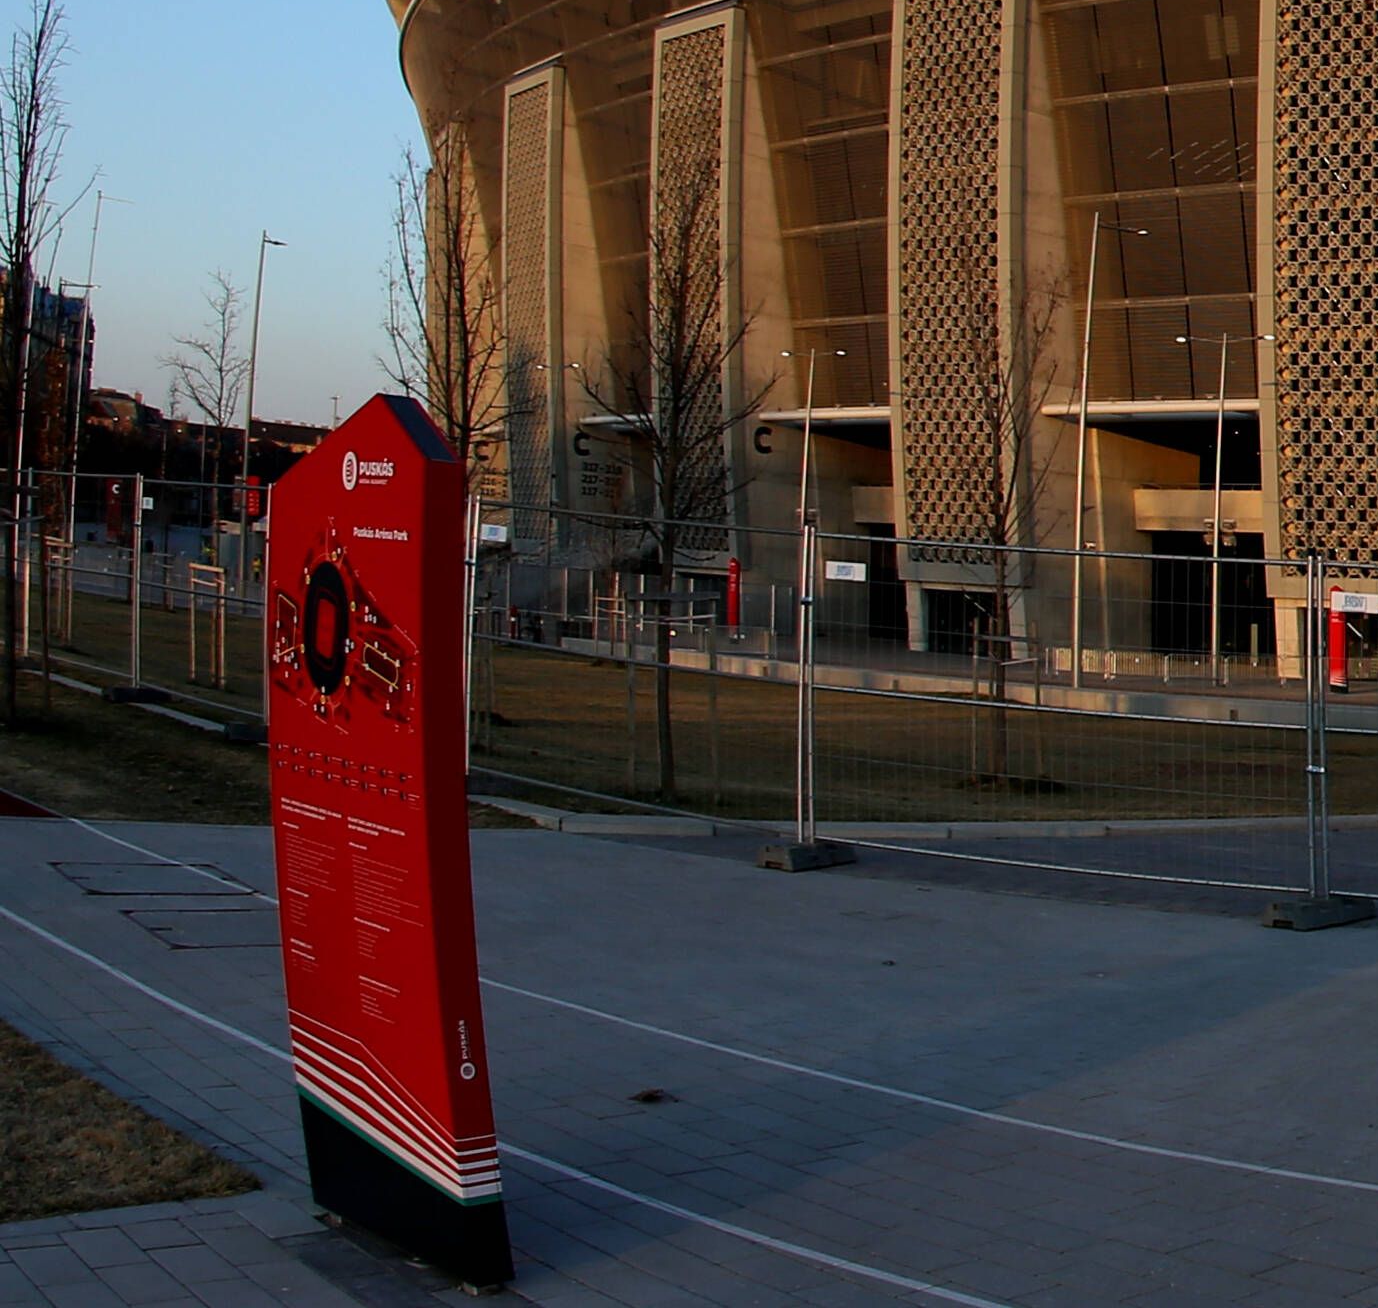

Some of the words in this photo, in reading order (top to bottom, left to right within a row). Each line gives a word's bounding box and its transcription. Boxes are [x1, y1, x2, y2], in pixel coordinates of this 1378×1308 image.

[574, 431, 591, 456] C
[754, 426, 773, 454] C
[360, 458, 394, 476] PUSKÁS
[111, 483, 120, 494] C
